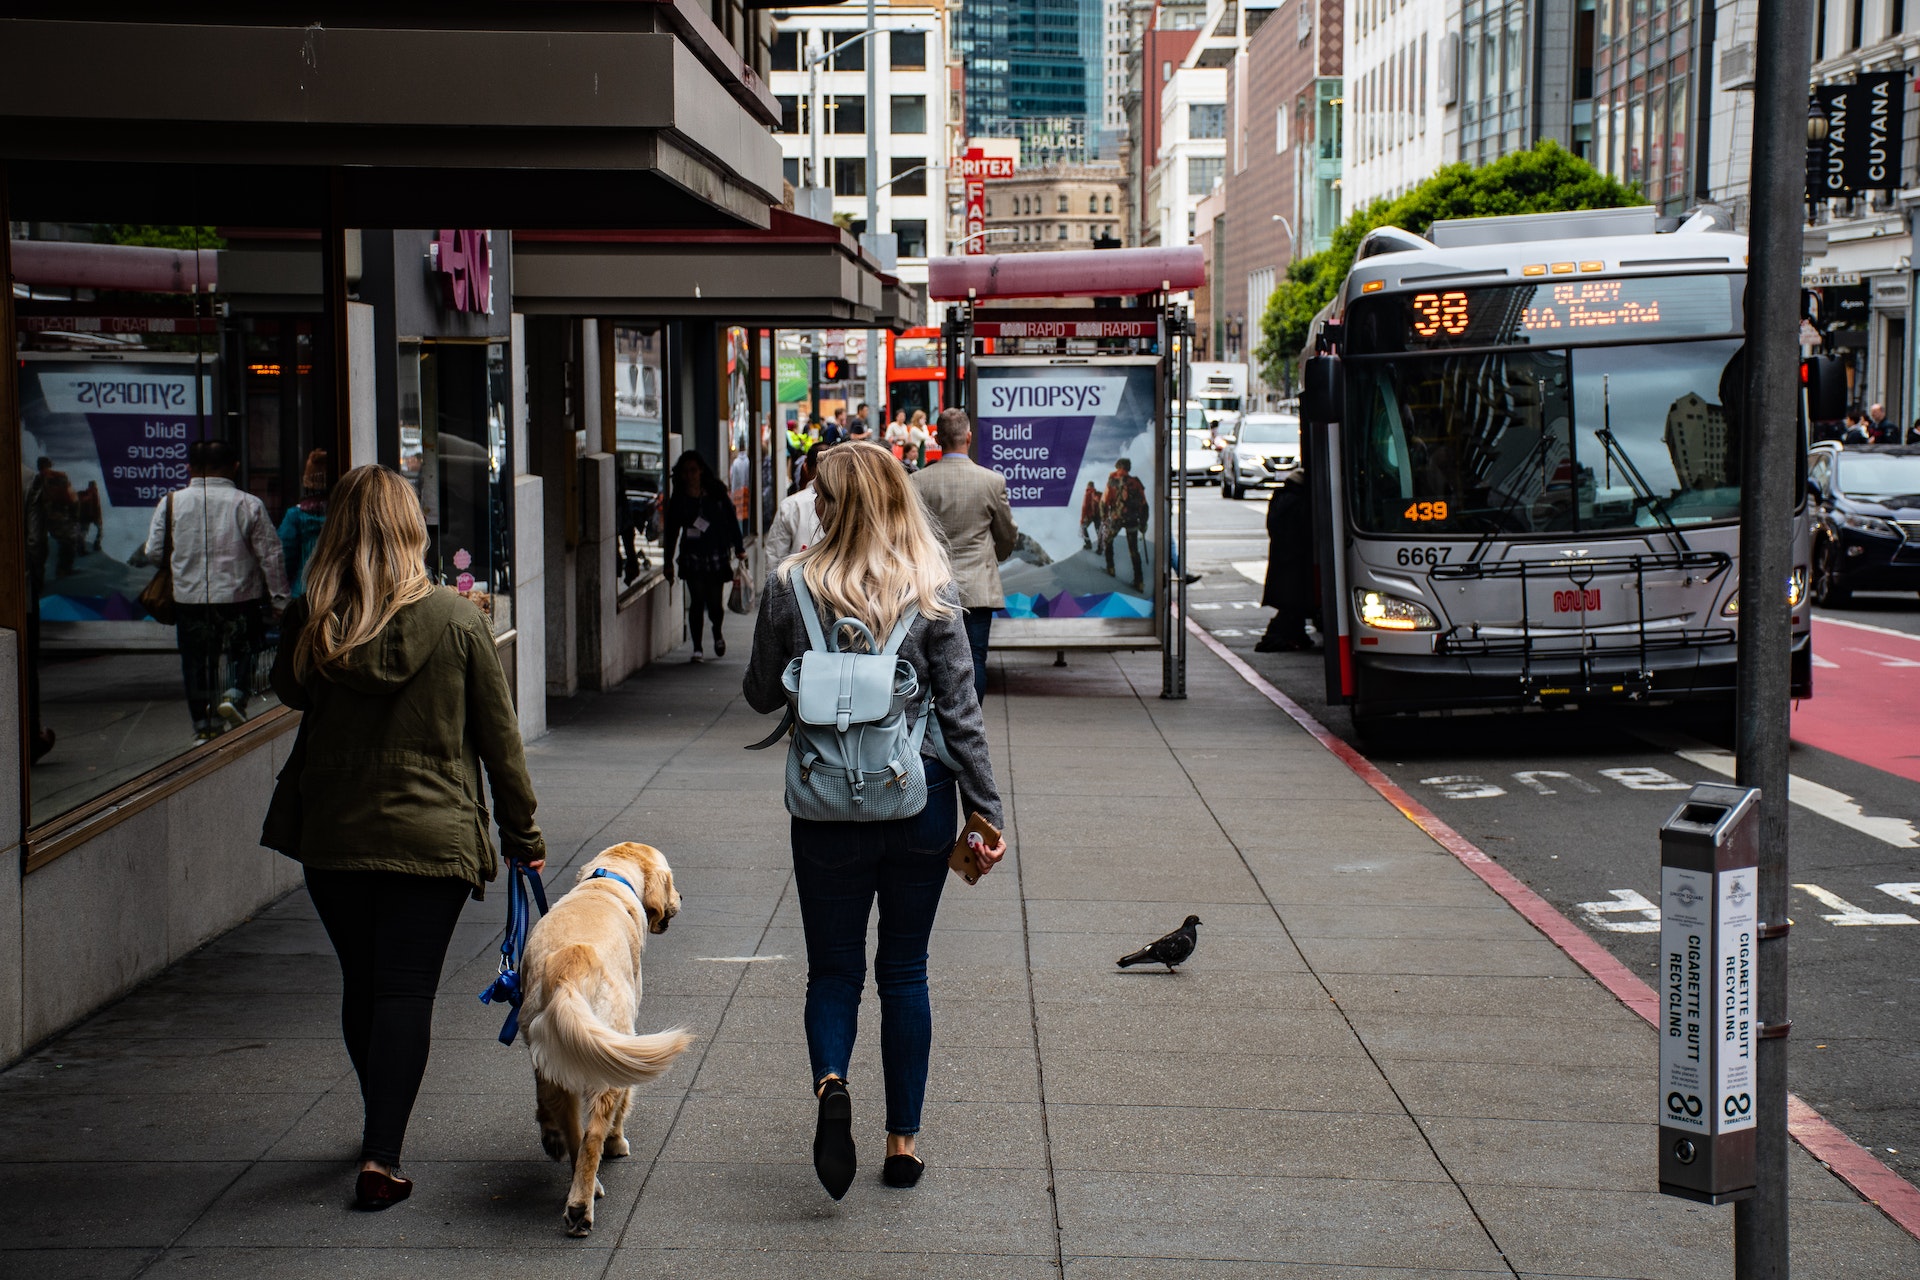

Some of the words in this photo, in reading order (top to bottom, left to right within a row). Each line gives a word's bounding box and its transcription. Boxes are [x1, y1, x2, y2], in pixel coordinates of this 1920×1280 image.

[1046, 117, 1072, 131] THE
[1868, 81, 1889, 181] CUYANA
[1032, 135, 1084, 149] PALACE
[1827, 93, 1847, 189] CUYANA
[953, 158, 1012, 177] BRITEX
[1802, 274, 1857, 284] POWELL
[1413, 292, 1469, 336] 38
[1028, 323, 1065, 336] RAPID
[1103, 323, 1141, 336] RAPID
[992, 424, 1032, 441] Build
[992, 444, 1049, 460] Secure
[1005, 485, 1044, 500] aster
[1404, 501, 1447, 522] 439
[1397, 547, 1452, 566] 6667
[1688, 935, 1700, 1019] CIGARETTE
[1739, 933, 1749, 1016] CIGARETTE
[1670, 953, 1682, 1037] RECYCLING
[1726, 956, 1735, 1041] RECYCLING
[1687, 1023, 1700, 1063] BUTT
[1739, 1021, 1749, 1059] BUTT
[1667, 1114, 1703, 1126] TERRACYCLE
[1724, 1115, 1751, 1125] TERRACYCLE
